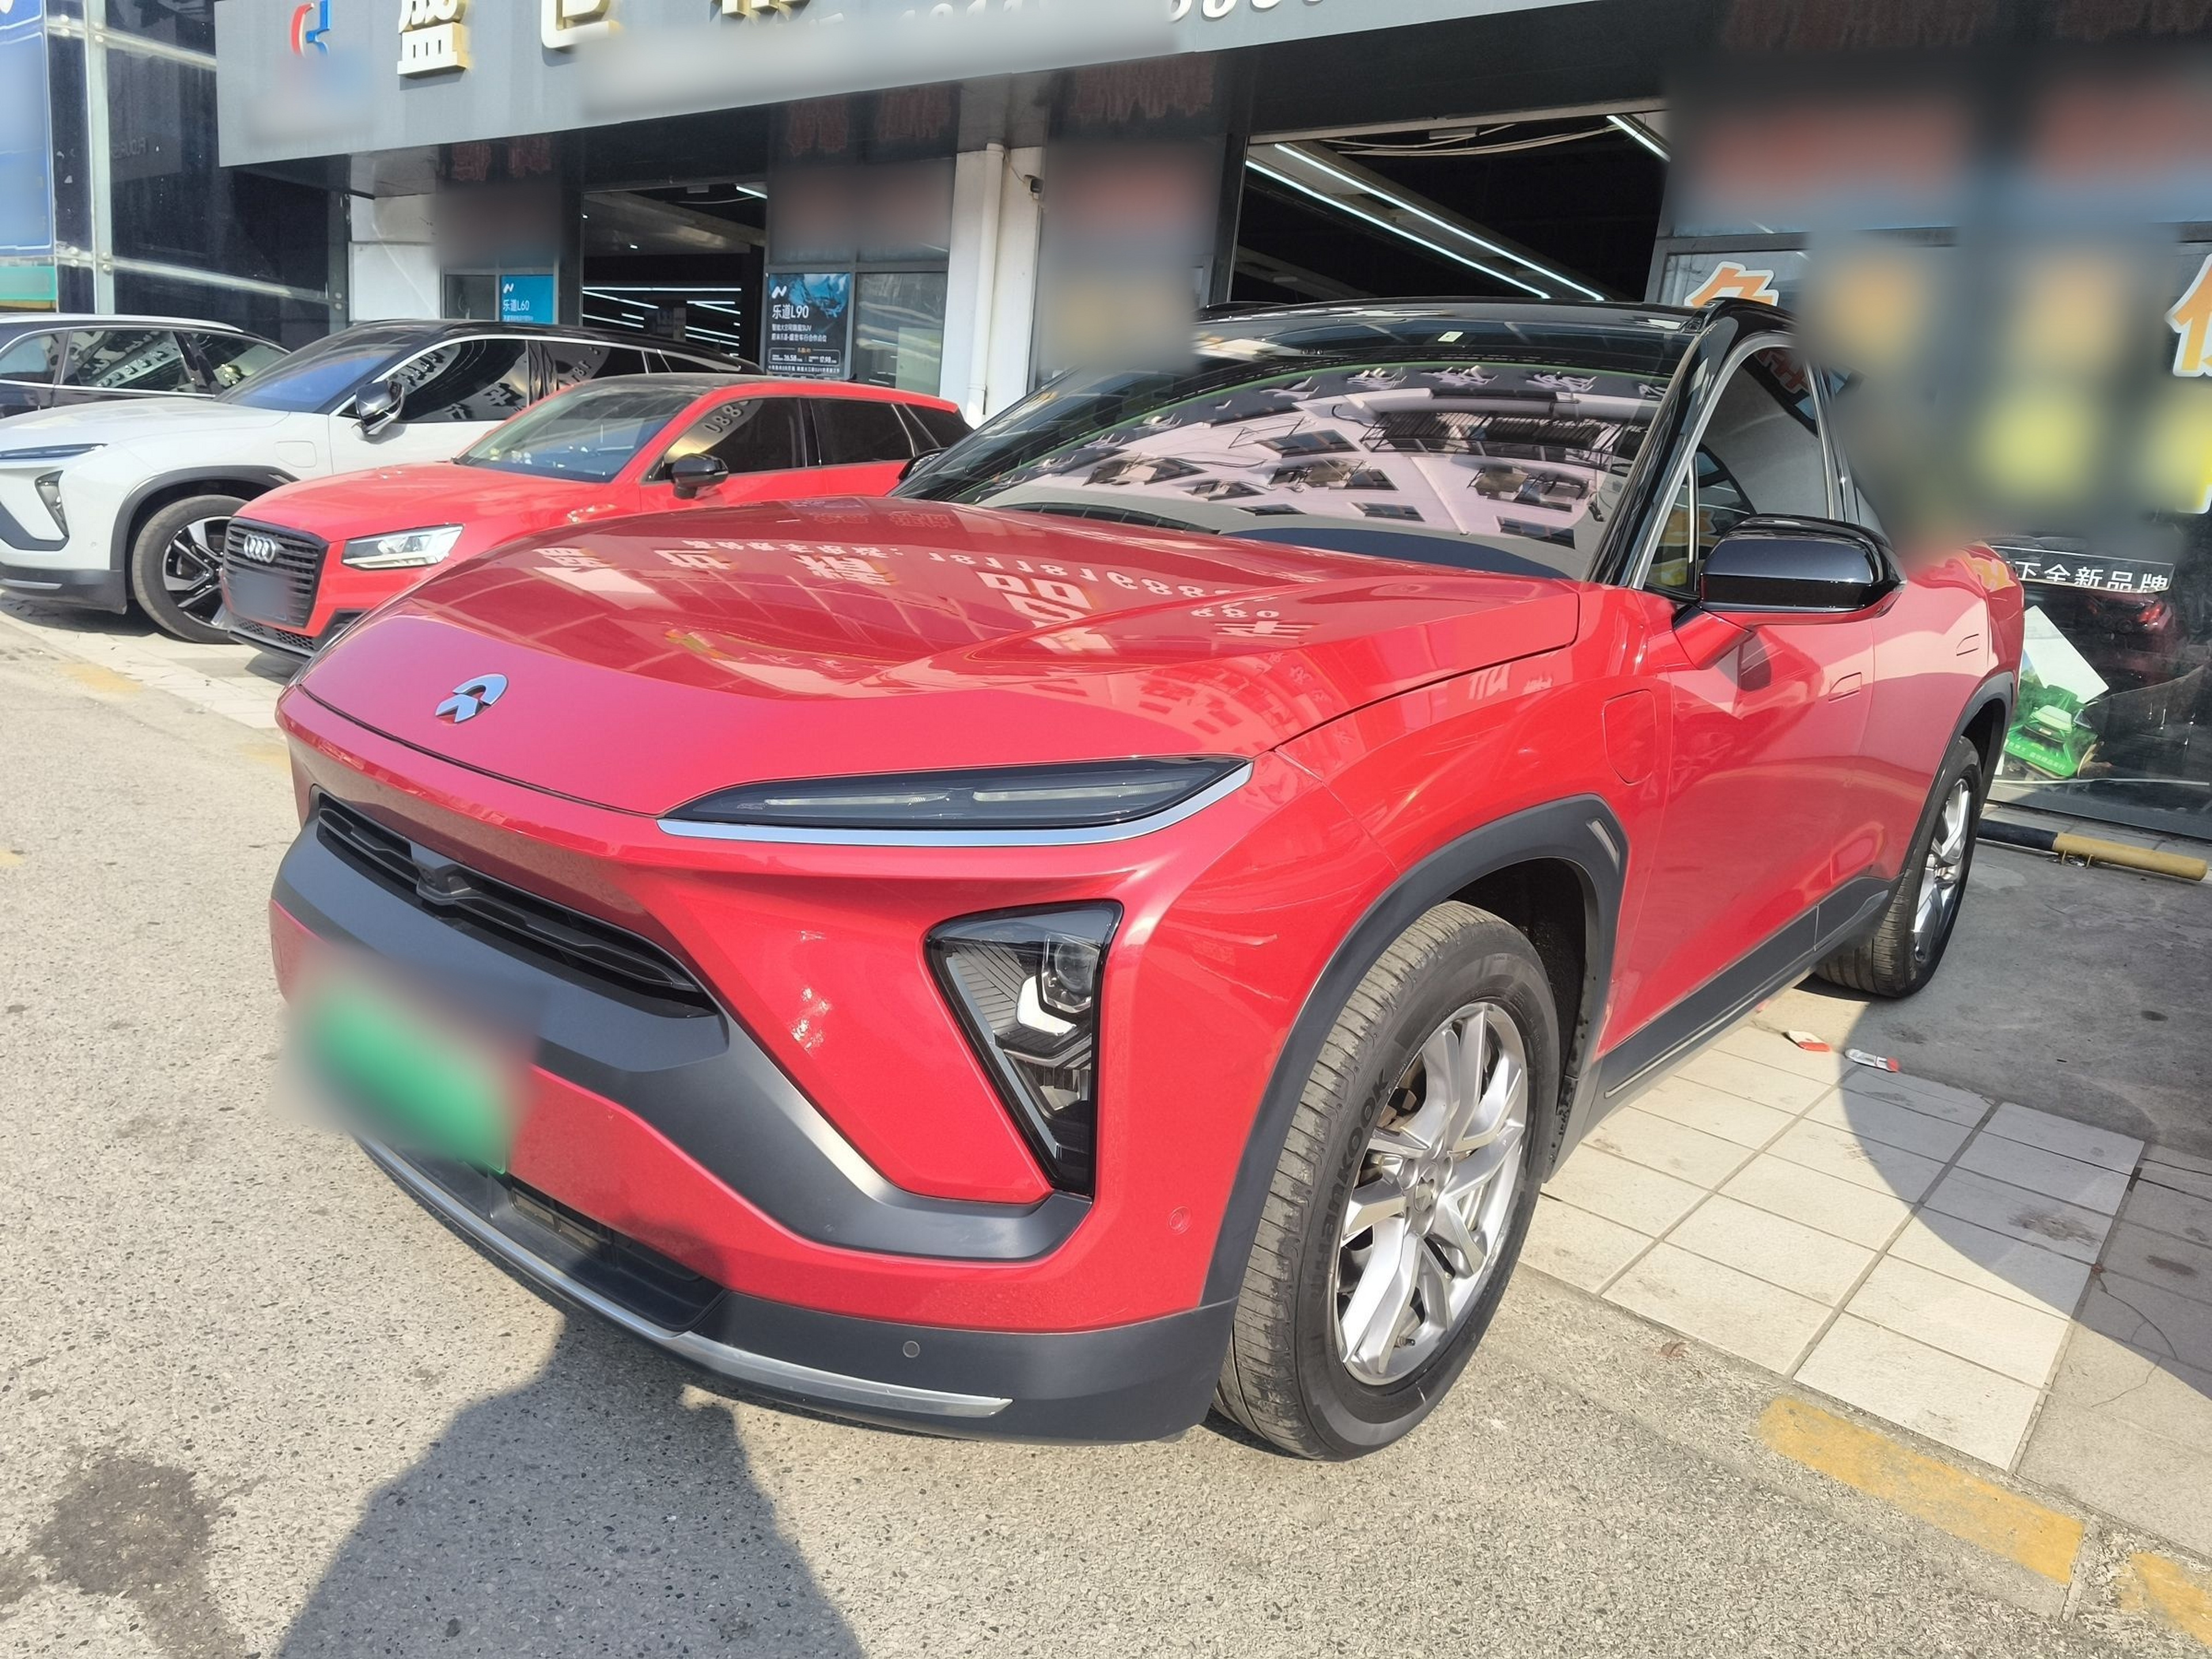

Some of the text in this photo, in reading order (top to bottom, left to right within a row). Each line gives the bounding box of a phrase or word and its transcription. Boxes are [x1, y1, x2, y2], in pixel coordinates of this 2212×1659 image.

[502, 298, 531, 312] 乐道L60
[771, 303, 810, 320] 乐道L90
[2006, 560, 2169, 593] 下全新品牌
